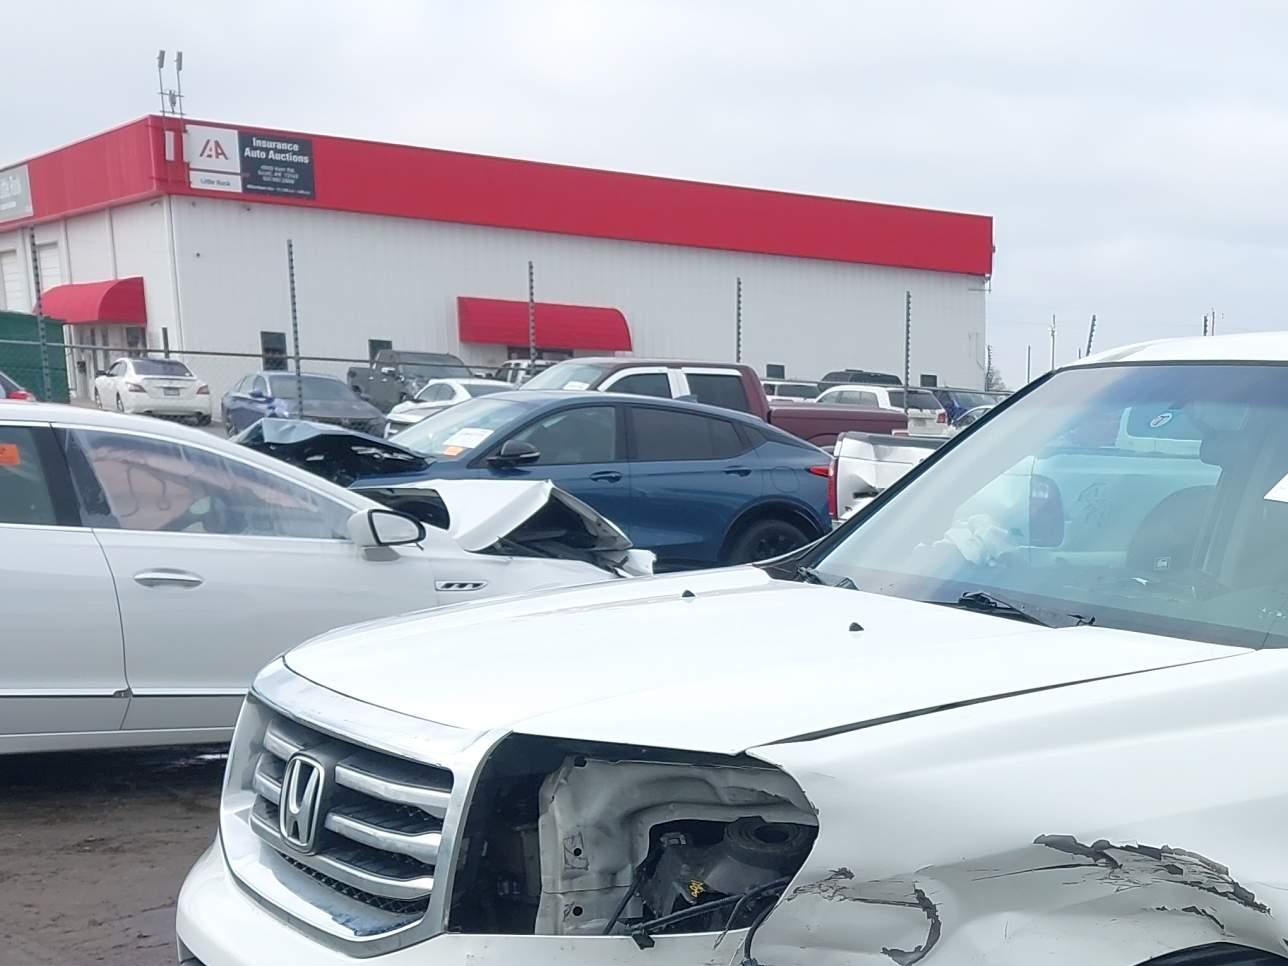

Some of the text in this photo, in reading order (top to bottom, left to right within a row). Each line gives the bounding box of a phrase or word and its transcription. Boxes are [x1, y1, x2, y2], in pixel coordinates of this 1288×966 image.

[252, 137, 299, 152] Insurance
[244, 147, 309, 164] Auto Auctions
